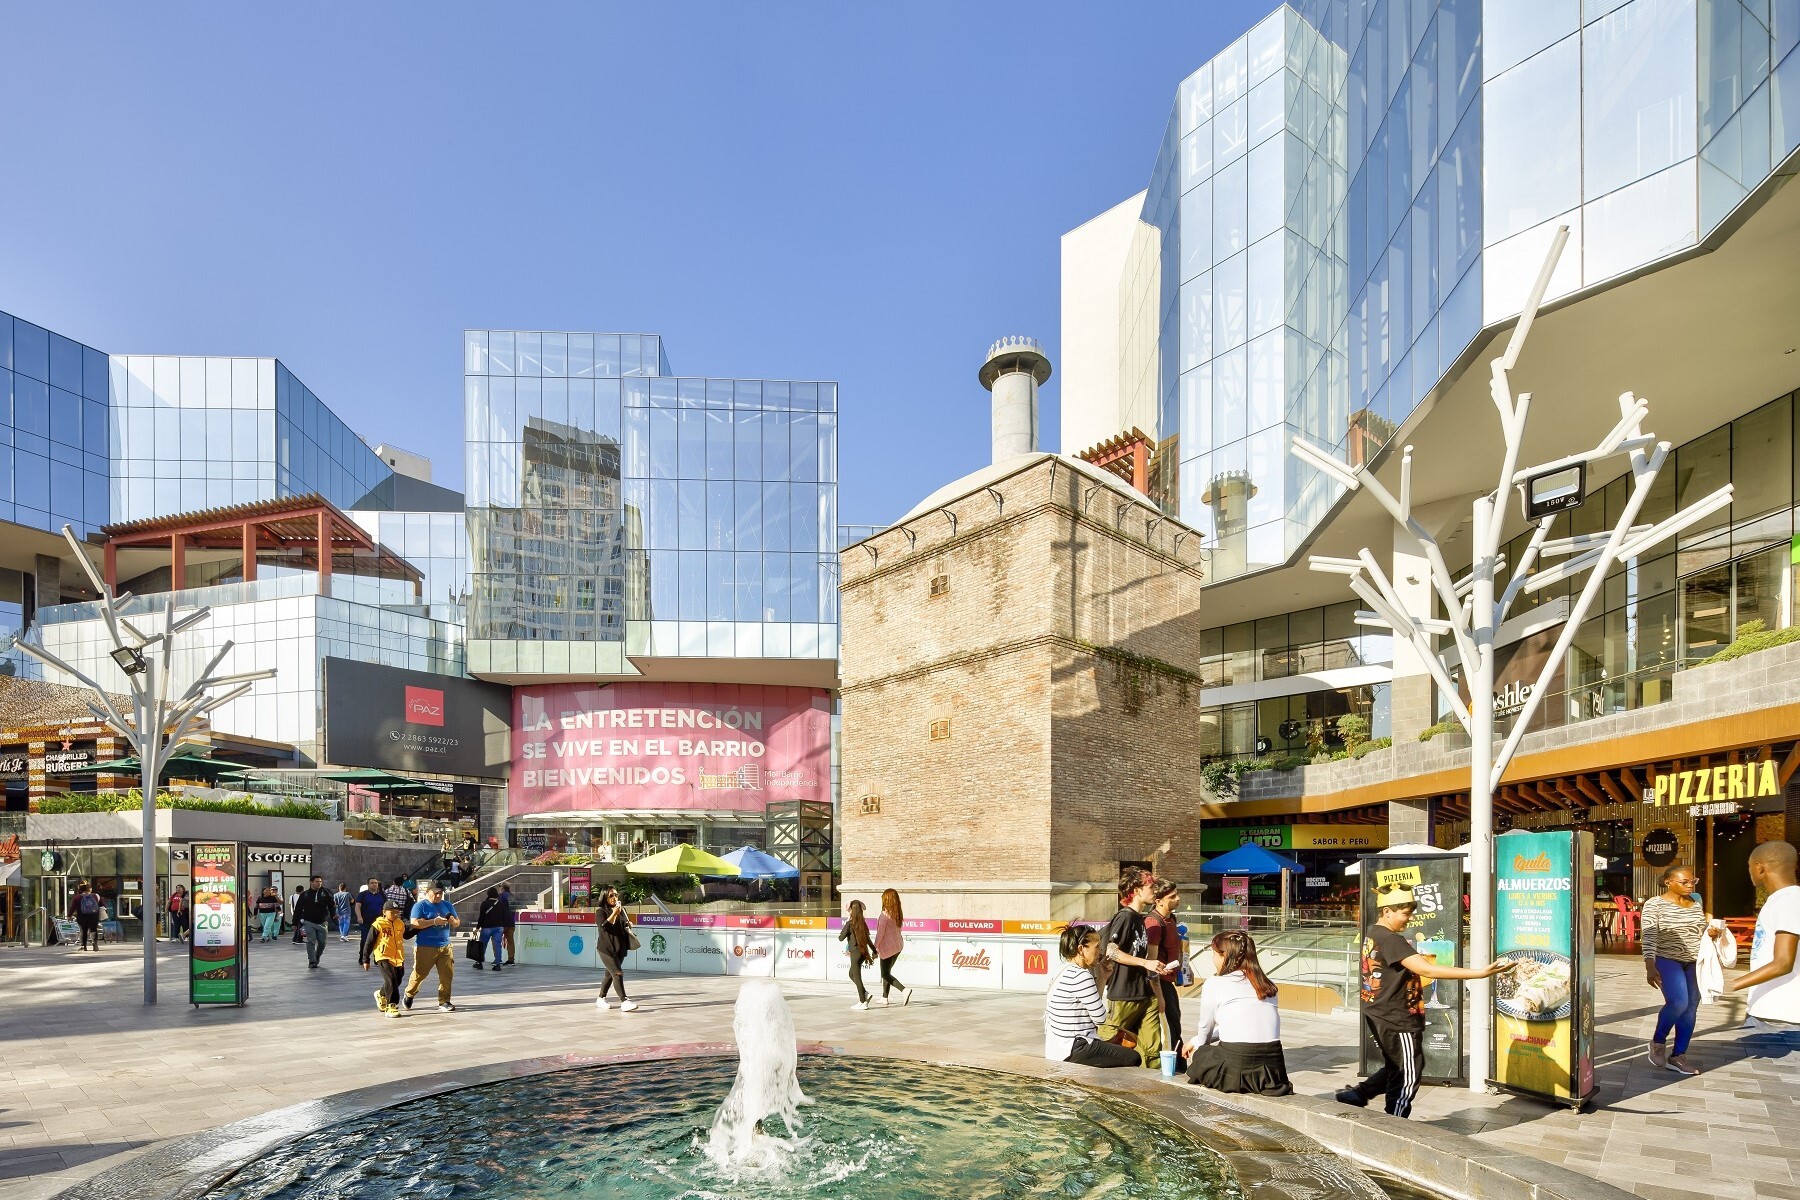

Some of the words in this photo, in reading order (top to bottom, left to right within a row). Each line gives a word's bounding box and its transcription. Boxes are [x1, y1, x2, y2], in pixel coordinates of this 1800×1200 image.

[1492, 680, 1537, 709] shle
[413, 704, 440, 716] PAZ
[522, 712, 553, 732] LA
[560, 706, 762, 730] ENTRETENCIÓN
[407, 734, 427, 743] 2863
[428, 736, 459, 746] 5922/23
[403, 744, 447, 754] www.paz.cl
[522, 742, 547, 759] SE
[552, 740, 603, 758] VIVE
[609, 739, 638, 756] EN
[645, 739, 671, 756] EL
[678, 740, 766, 758] BARRIO
[45, 761, 88, 773] BURGERS
[523, 766, 686, 788] BIENVENIDOS
[781, 770, 804, 778] Barrio
[764, 778, 818, 787] Independencia
[1654, 760, 1779, 807] PIZZERIA
[1702, 801, 1735, 816] BARRIO
[1248, 828, 1280, 836] GUARAN
[1349, 836, 1369, 845] PERÚ
[1648, 843, 1671, 852] PIZZERIA
[265, 853, 312, 863] COFFEE
[1514, 852, 1551, 872] tquila
[1383, 871, 1414, 883] PIZZERIA
[203, 881, 227, 893] DÍAS!
[1497, 877, 1571, 891] ALMUERZOS
[1533, 892, 1557, 900] VIERNES
[1416, 912, 1436, 921] TUYO
[948, 921, 994, 929] BOULEVARD
[744, 945, 767, 958] family
[787, 947, 815, 959] tricot
[951, 948, 992, 970] tquila
